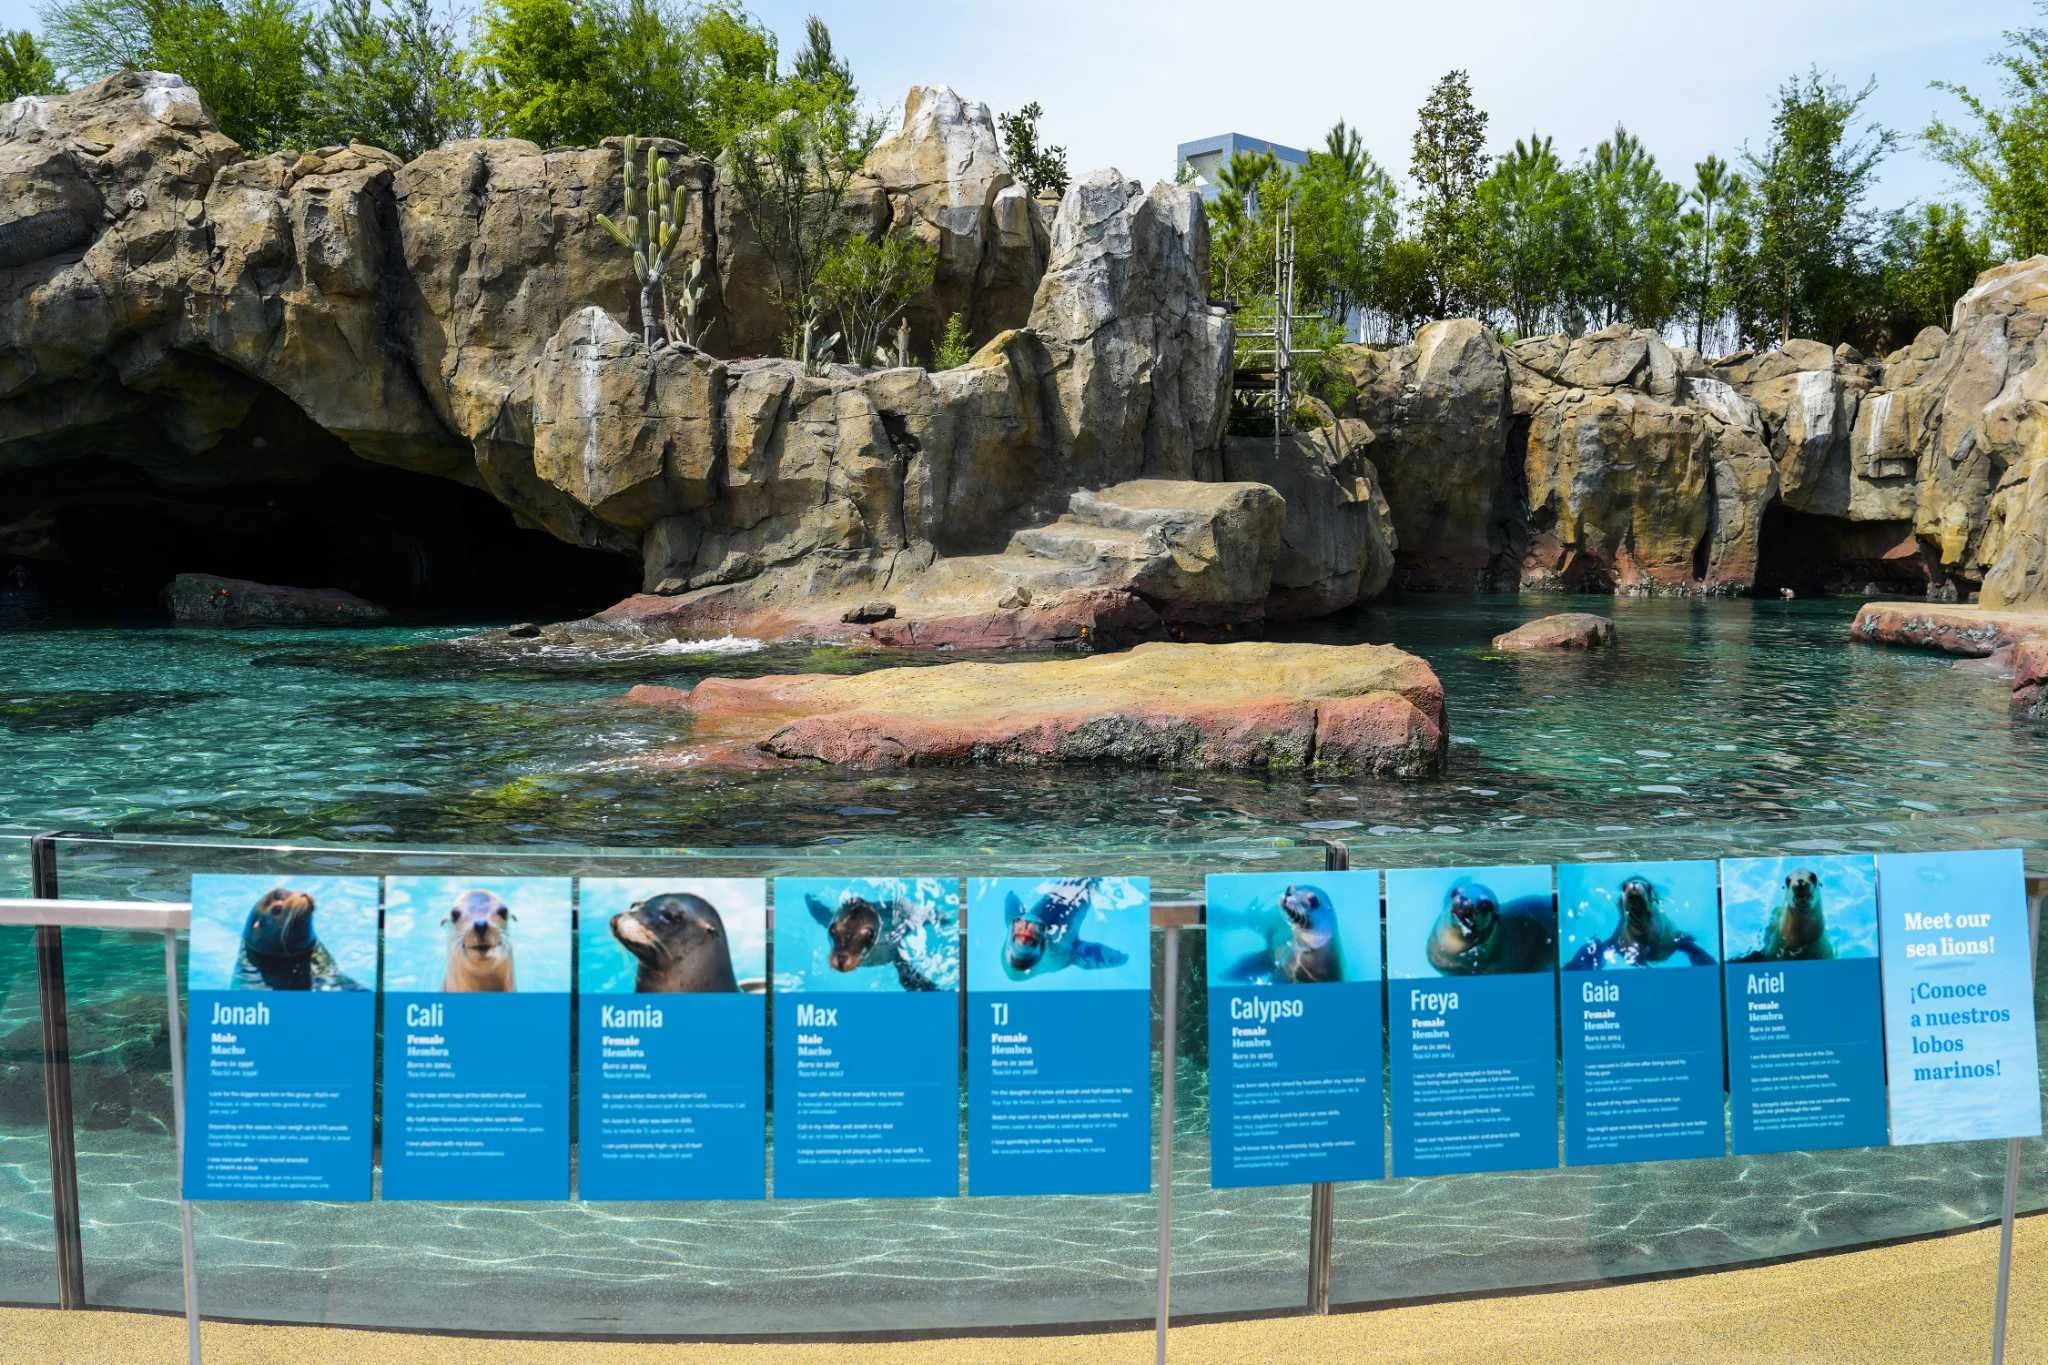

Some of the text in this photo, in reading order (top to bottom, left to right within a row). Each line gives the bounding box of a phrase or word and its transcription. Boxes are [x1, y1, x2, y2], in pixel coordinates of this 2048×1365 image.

[1904, 912, 1990, 930] Meet our
[1906, 936, 1994, 958] sea lions!
[1747, 972, 1784, 994] Ariel
[1583, 980, 1619, 1003] Gaia
[1911, 982, 1986, 1004] ¡Conoce
[1411, 990, 1458, 1015] Freya
[1748, 1001, 1779, 1010] Female
[212, 1002, 270, 1025] Jonah
[991, 1003, 1008, 1025] TJ
[1231, 996, 1303, 1023] Calypso
[1584, 1009, 1616, 1019] Female
[407, 1004, 443, 1027] Cali
[602, 1004, 663, 1028] Kamia
[797, 1004, 837, 1026] Max
[1749, 1012, 1783, 1022] Hembra
[1911, 1008, 2010, 1027] a nuestros
[1412, 1018, 1445, 1028] Female
[1584, 1021, 1620, 1030] Hembra
[1232, 1026, 1267, 1036] Female
[1412, 1029, 1450, 1039] Hembra
[212, 1033, 237, 1043] Male
[407, 1034, 444, 1044] Female
[602, 1036, 640, 1046] Female
[798, 1034, 823, 1044] Male
[992, 1033, 1028, 1043] Female
[1232, 1037, 1271, 1048] Hembra
[212, 1045, 246, 1054] Macho
[992, 1044, 1032, 1054] Hembra
[1912, 1035, 1964, 1054] lobos
[407, 1046, 448, 1056] Hembra
[602, 1048, 644, 1057] Hembra
[798, 1046, 832, 1056] Macho
[1914, 1059, 2000, 1080] marinos!
